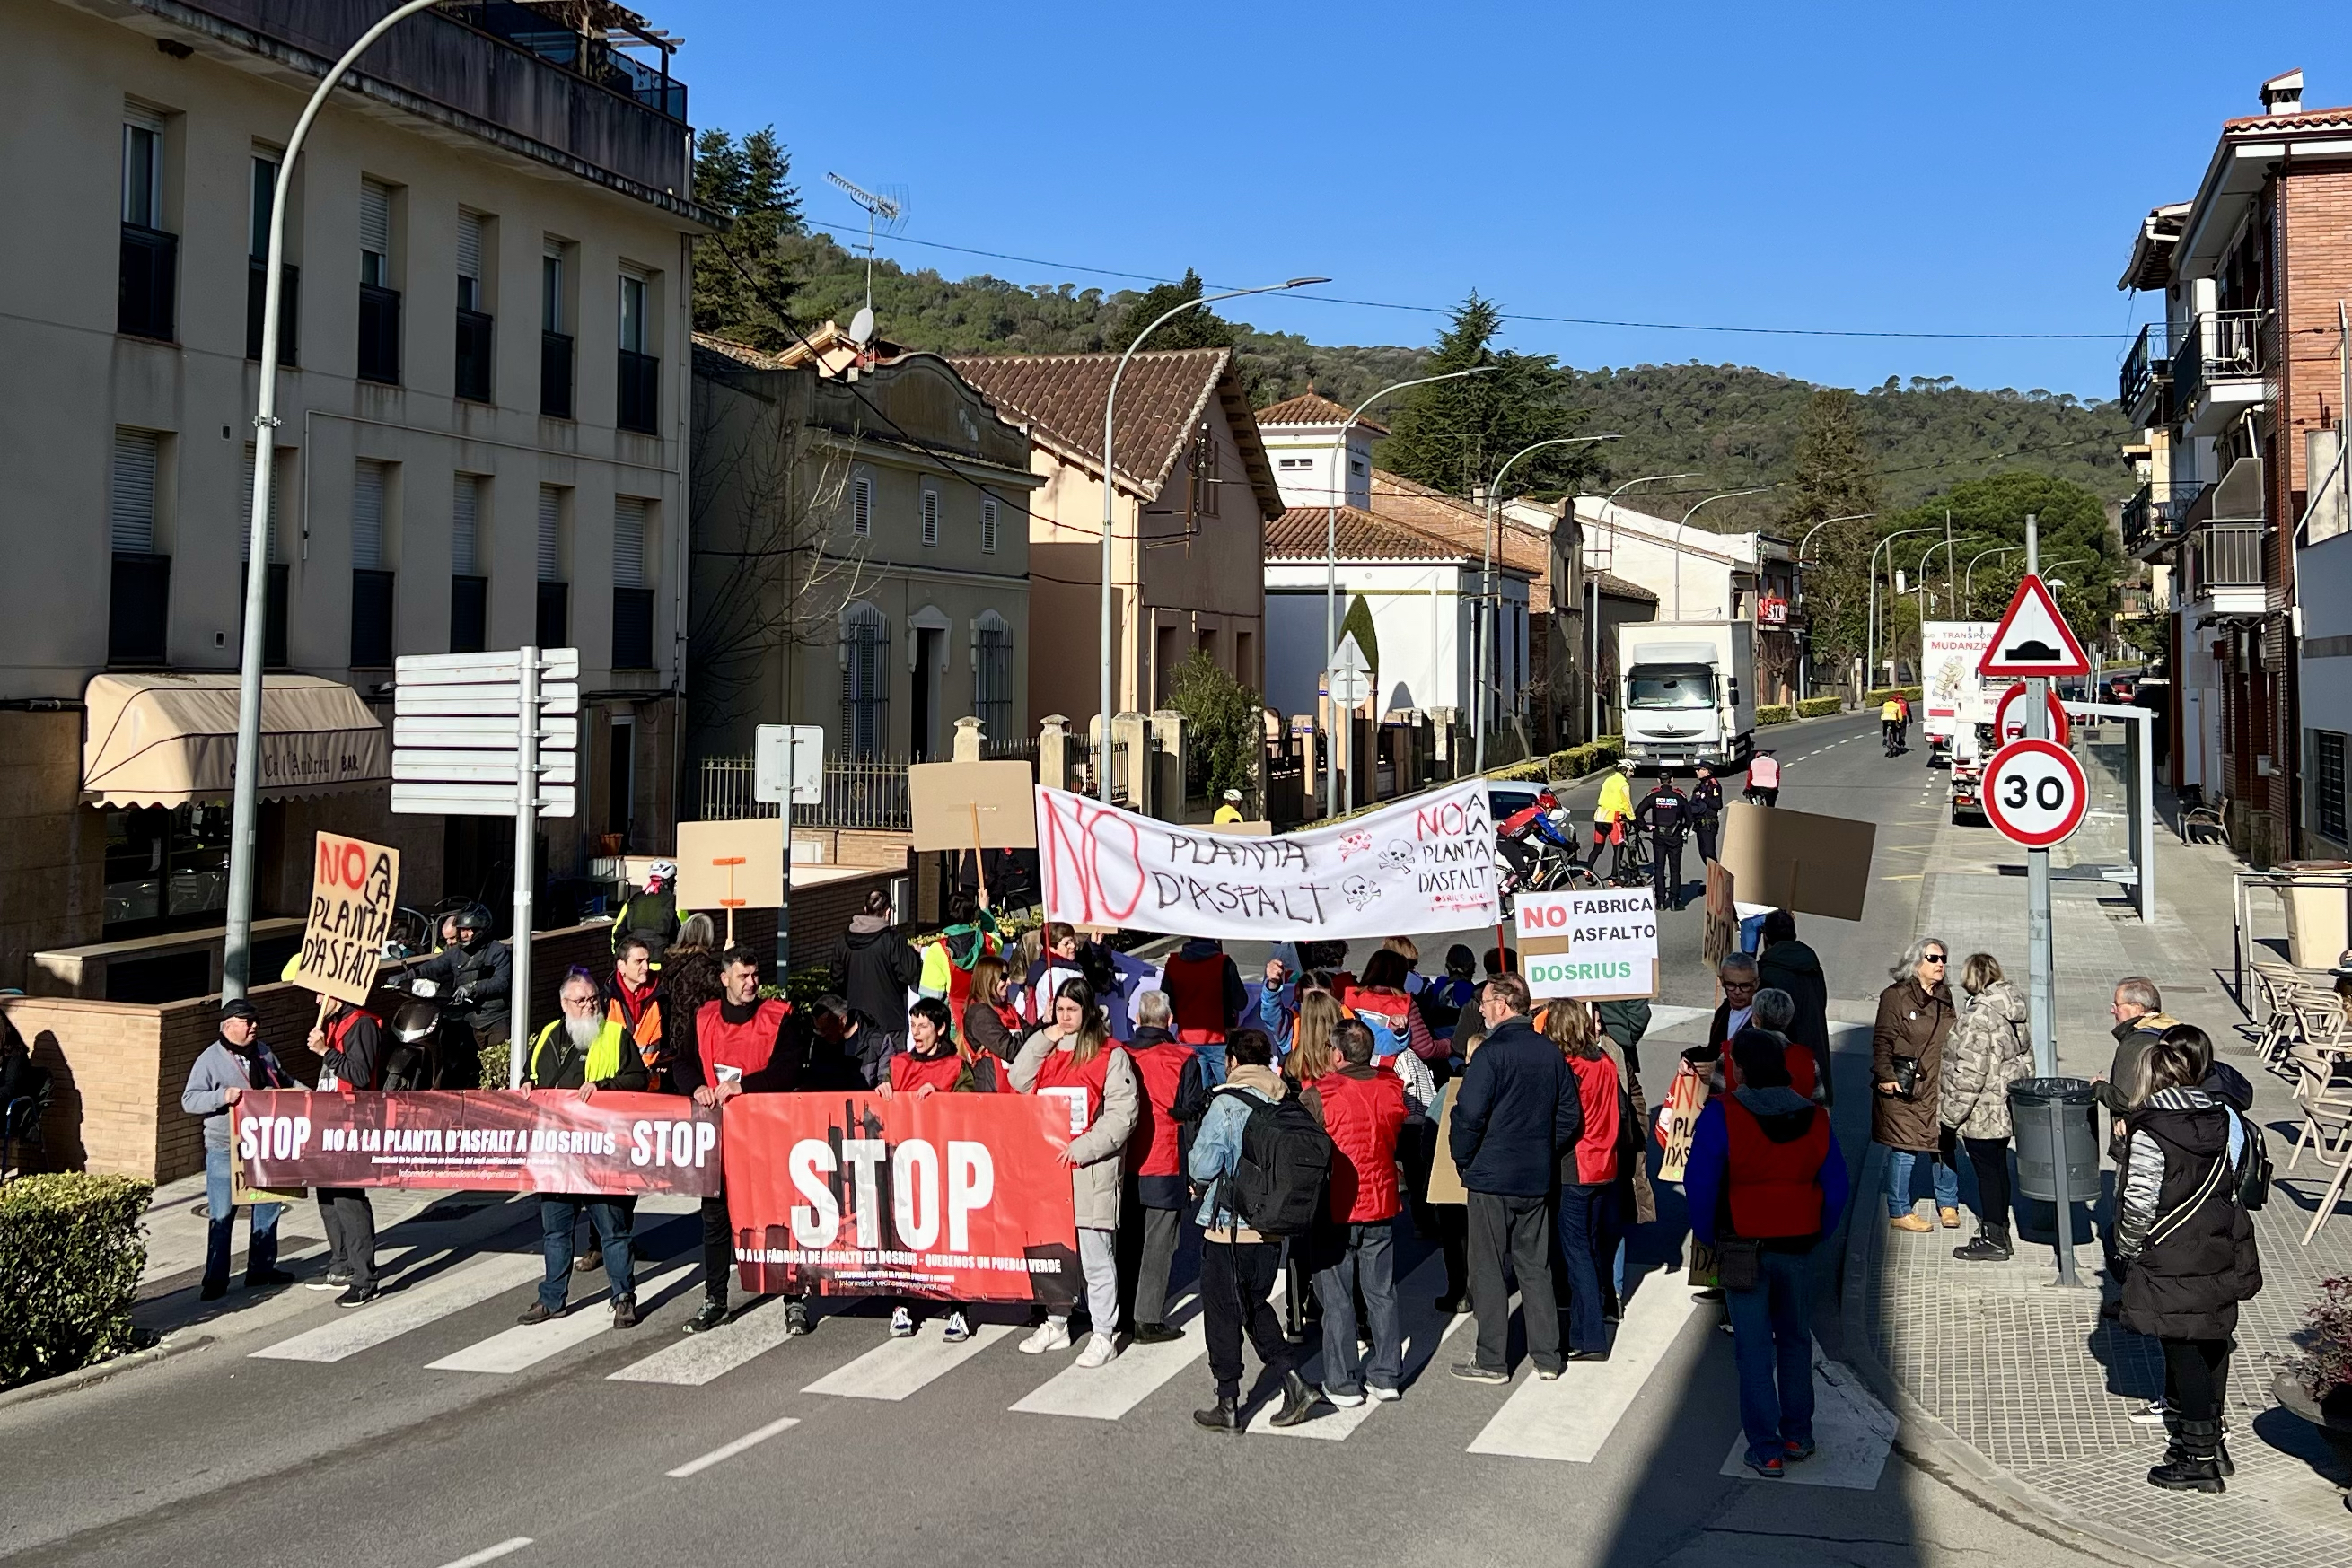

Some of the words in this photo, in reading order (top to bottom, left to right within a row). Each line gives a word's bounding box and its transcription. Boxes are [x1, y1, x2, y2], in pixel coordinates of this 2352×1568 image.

[1931, 641, 1988, 650] MUDANZA
[341, 754, 359, 772] BAR
[2004, 775, 2064, 810] 30
[1417, 802, 1464, 841] NO
[1466, 793, 1486, 812] A
[1465, 814, 1488, 836] LA
[320, 840, 366, 890] NO
[371, 852, 391, 883] A
[1042, 792, 1145, 924] NO
[1166, 833, 1309, 872] PLANTA
[1423, 839, 1490, 864] PLANTA
[364, 879, 391, 909] LA
[1418, 866, 1489, 893] D'ASFALT
[1150, 871, 1330, 925] D'ASFALT
[1523, 906, 1567, 930] NO
[1573, 898, 1654, 915] FABRICA
[311, 896, 387, 948] PLANTA
[1573, 924, 1656, 942] ASFALTO
[299, 932, 382, 990] D'ASFALT
[1531, 961, 1631, 983] DOSRIUS
[241, 1117, 312, 1160] STOP
[322, 1129, 345, 1152] NO
[347, 1129, 358, 1152] A
[361, 1129, 381, 1152] LA
[383, 1129, 443, 1152] PLANTA
[445, 1129, 516, 1152] D'ASFALT
[516, 1130, 527, 1152] A
[531, 1130, 616, 1155] DOSRIUS
[630, 1120, 716, 1168] STOP
[1673, 1117, 1695, 1138] PL
[789, 1138, 995, 1252] STOP
[746, 1249, 752, 1262] A
[754, 1249, 766, 1263] LA
[766, 1248, 806, 1264] FÁBRICA
[808, 1250, 821, 1264] DE
[821, 1250, 863, 1264] ASFALTO
[864, 1250, 877, 1265] EN
[879, 1251, 917, 1266] DOSRIUS
[925, 1254, 975, 1269] QUEREMOS
[977, 1256, 990, 1270] UN
[992, 1257, 1027, 1272] PUEBLO
[1028, 1258, 1062, 1274] VERDE
